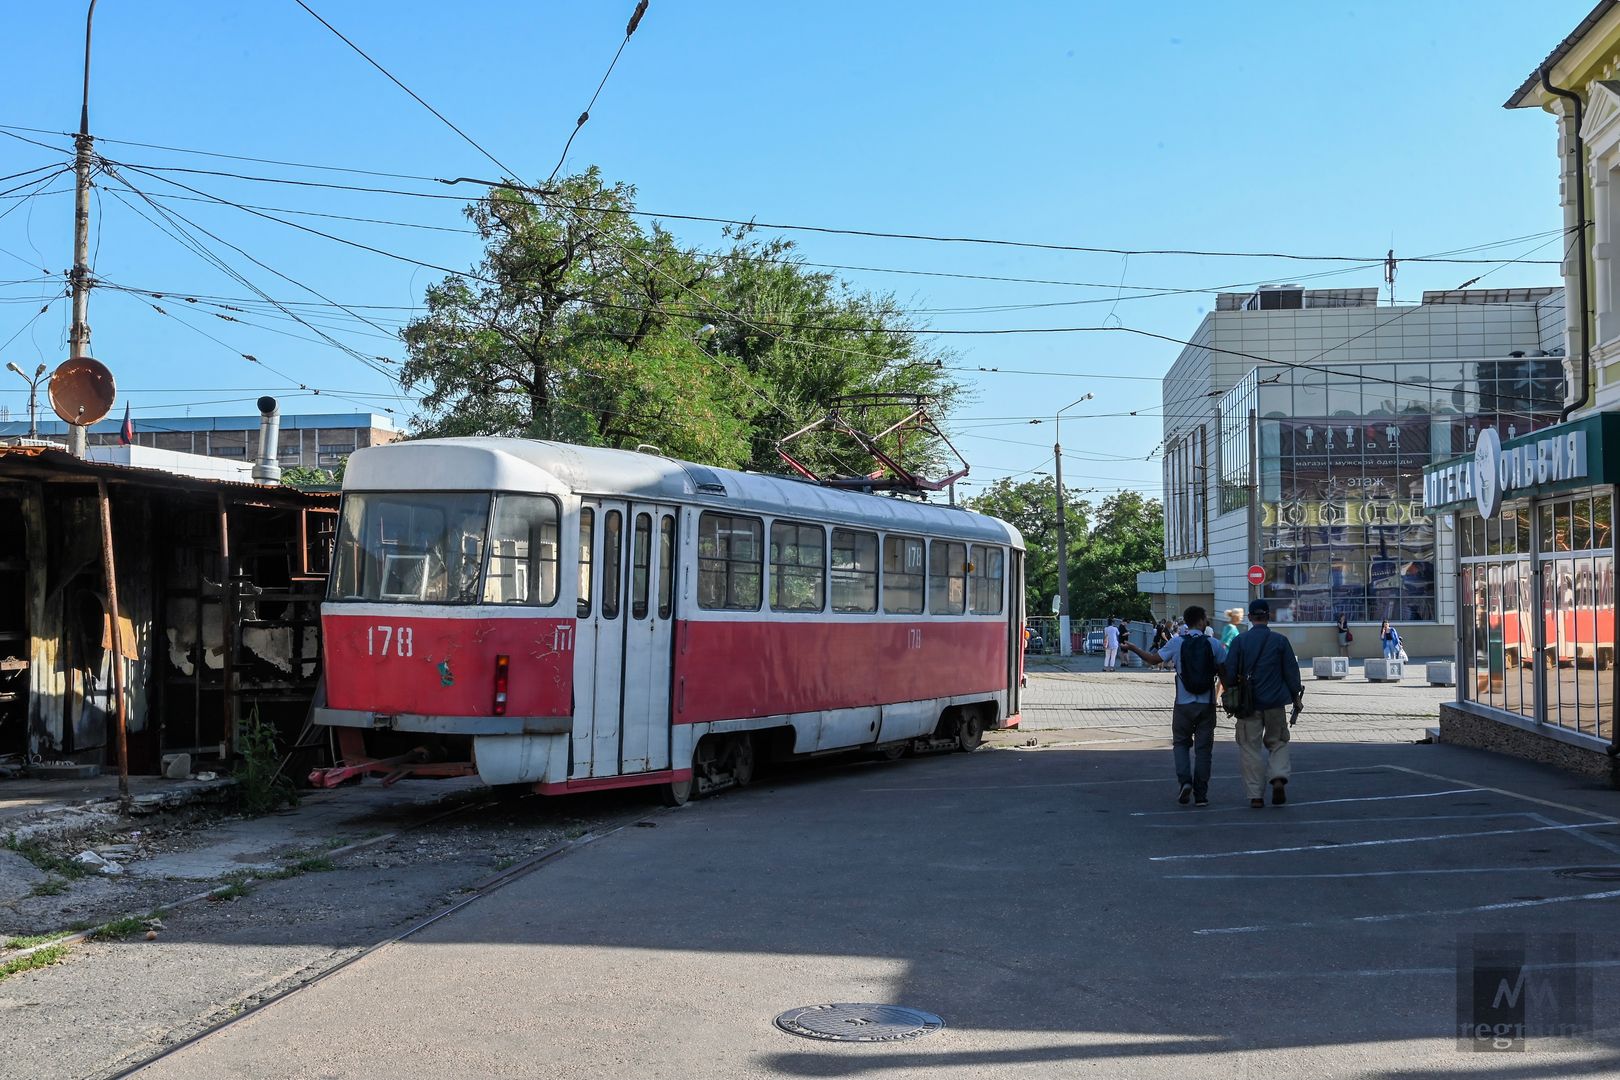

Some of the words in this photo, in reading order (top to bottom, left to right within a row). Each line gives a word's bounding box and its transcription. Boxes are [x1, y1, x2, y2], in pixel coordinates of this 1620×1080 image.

[1347, 477, 1385, 487] этаж
[1423, 461, 1476, 508] АПТЕКА
[1500, 430, 1587, 491] ОЛЬВИЯ
[908, 546, 922, 567] 178
[368, 625, 413, 657] 178
